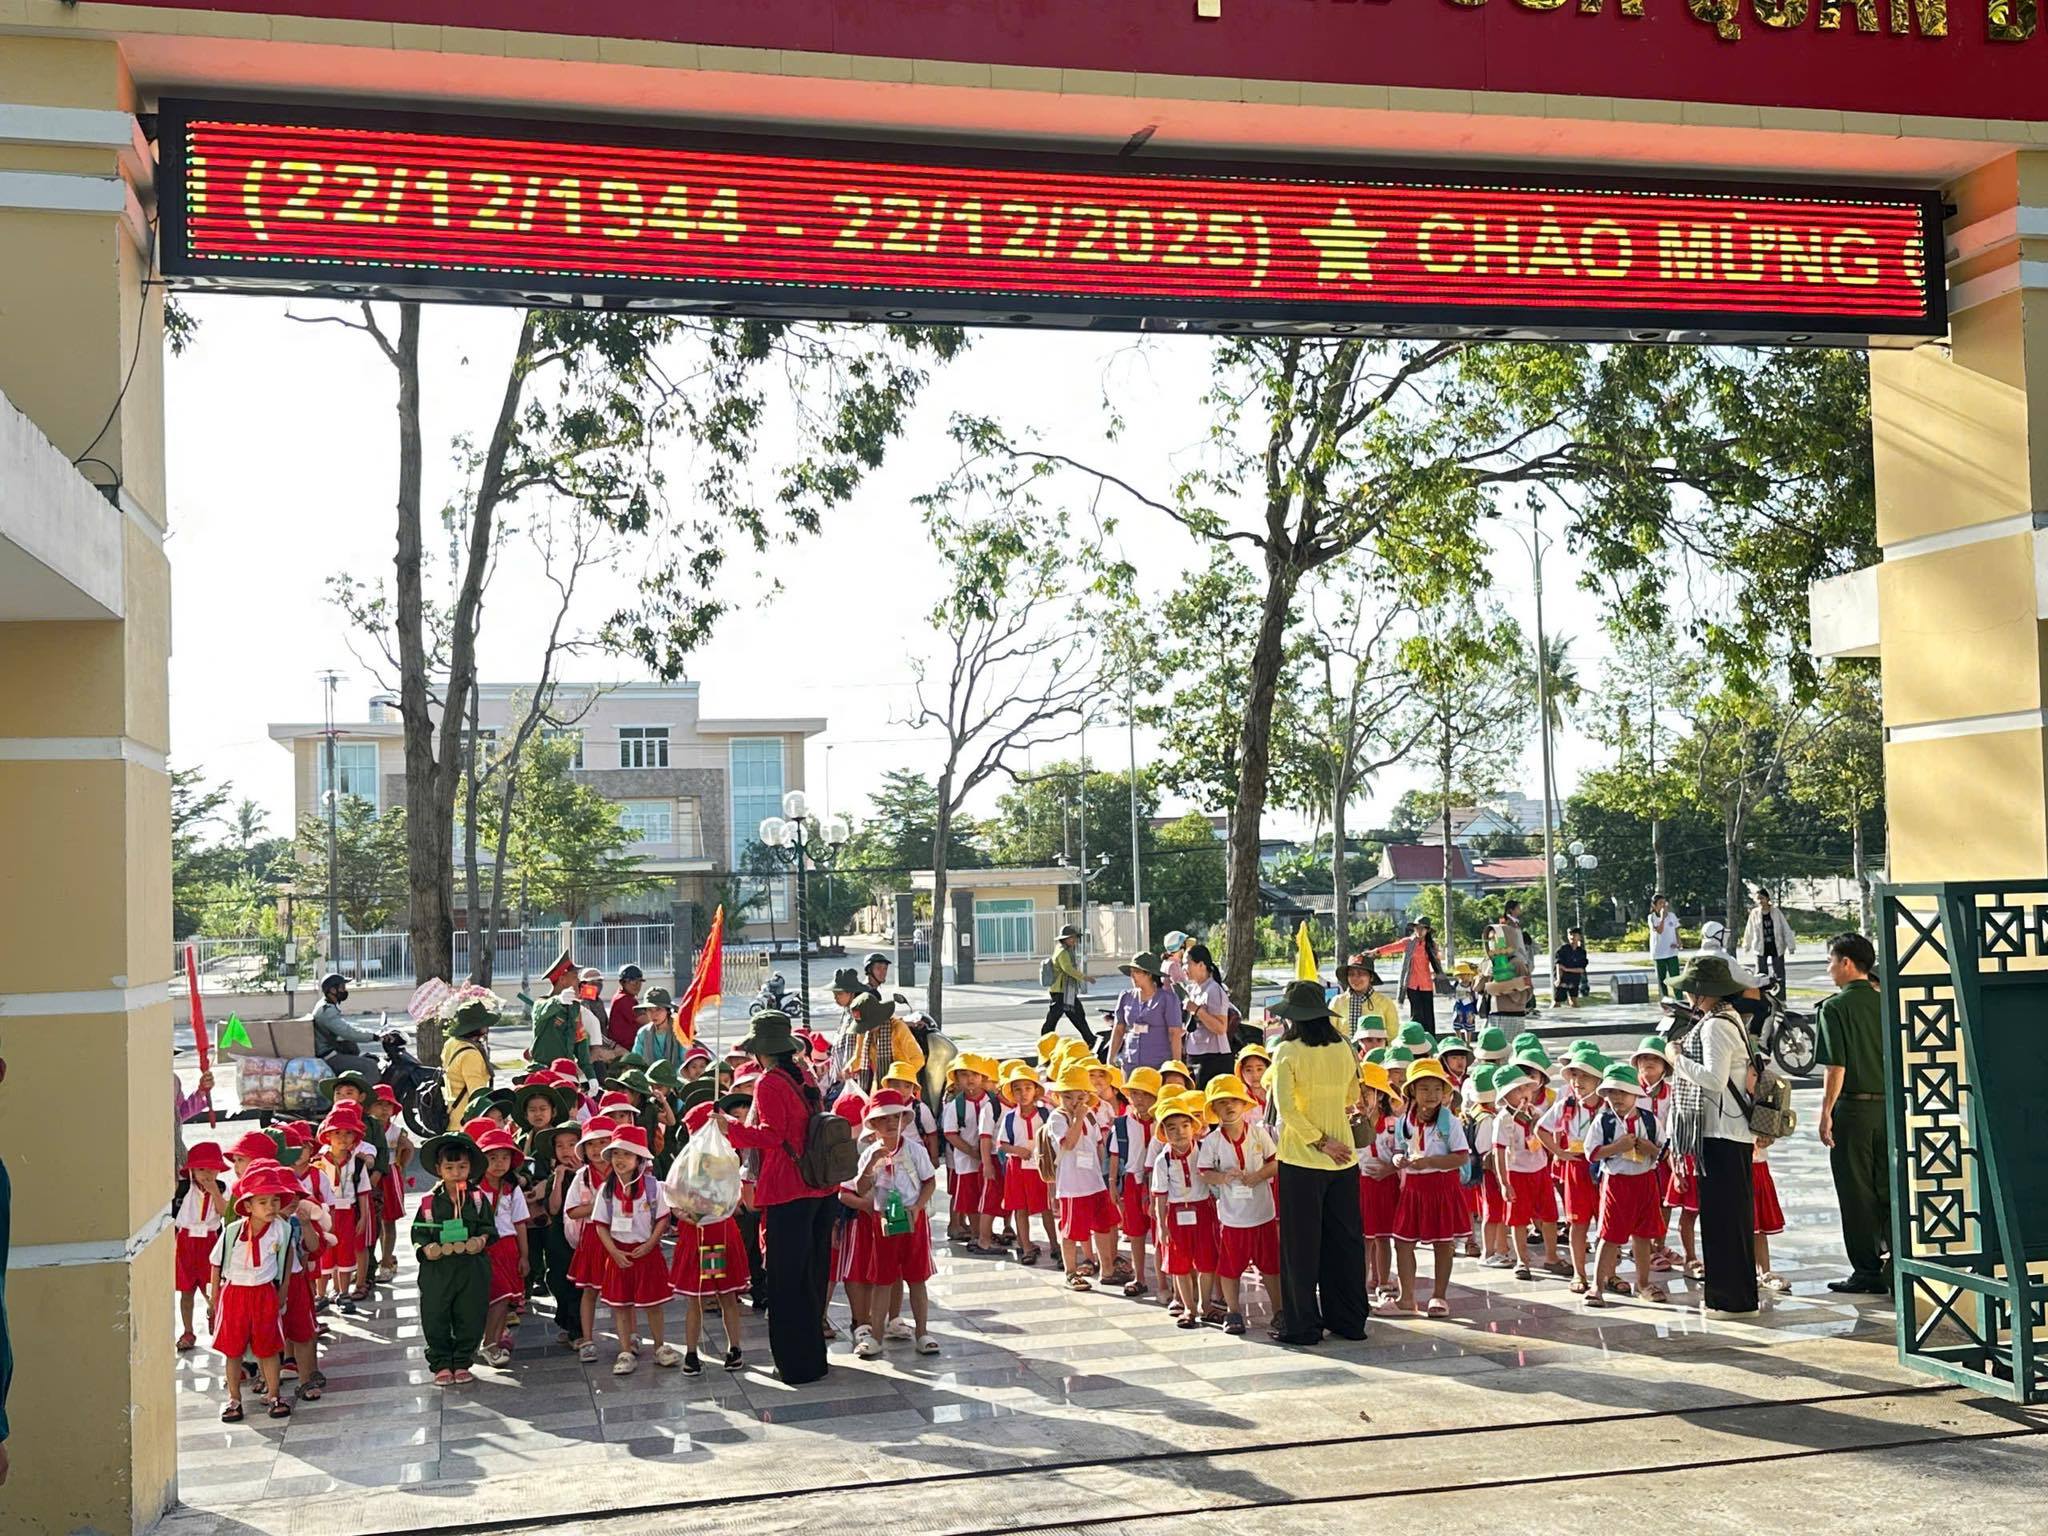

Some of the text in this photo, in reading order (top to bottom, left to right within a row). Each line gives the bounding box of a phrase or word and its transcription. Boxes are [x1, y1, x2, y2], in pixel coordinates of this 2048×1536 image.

[244, 161, 746, 241] (22/12/1944
[831, 193, 1270, 287] 22/12/2025)
[1418, 206, 1632, 276] CHÀO
